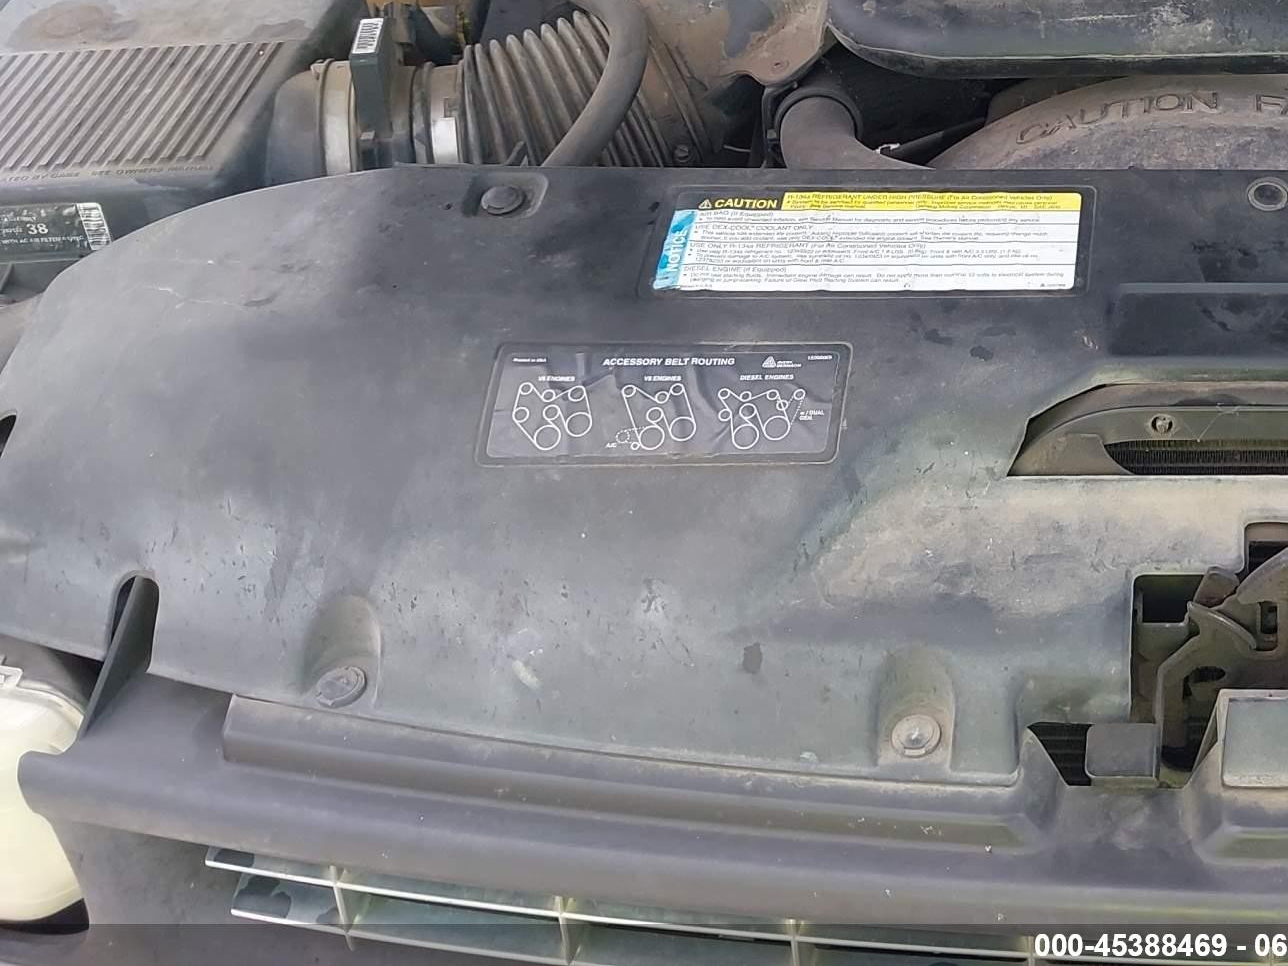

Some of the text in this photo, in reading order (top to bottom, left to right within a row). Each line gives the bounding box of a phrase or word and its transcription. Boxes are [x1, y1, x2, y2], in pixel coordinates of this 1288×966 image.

[1013, 90, 1220, 144] CAUTION
[714, 198, 779, 210] CAUTION
[26, 223, 49, 234] 38
[667, 229, 688, 273] NOTICE
[602, 357, 735, 366] ACCESSORY BELT ROUTING
